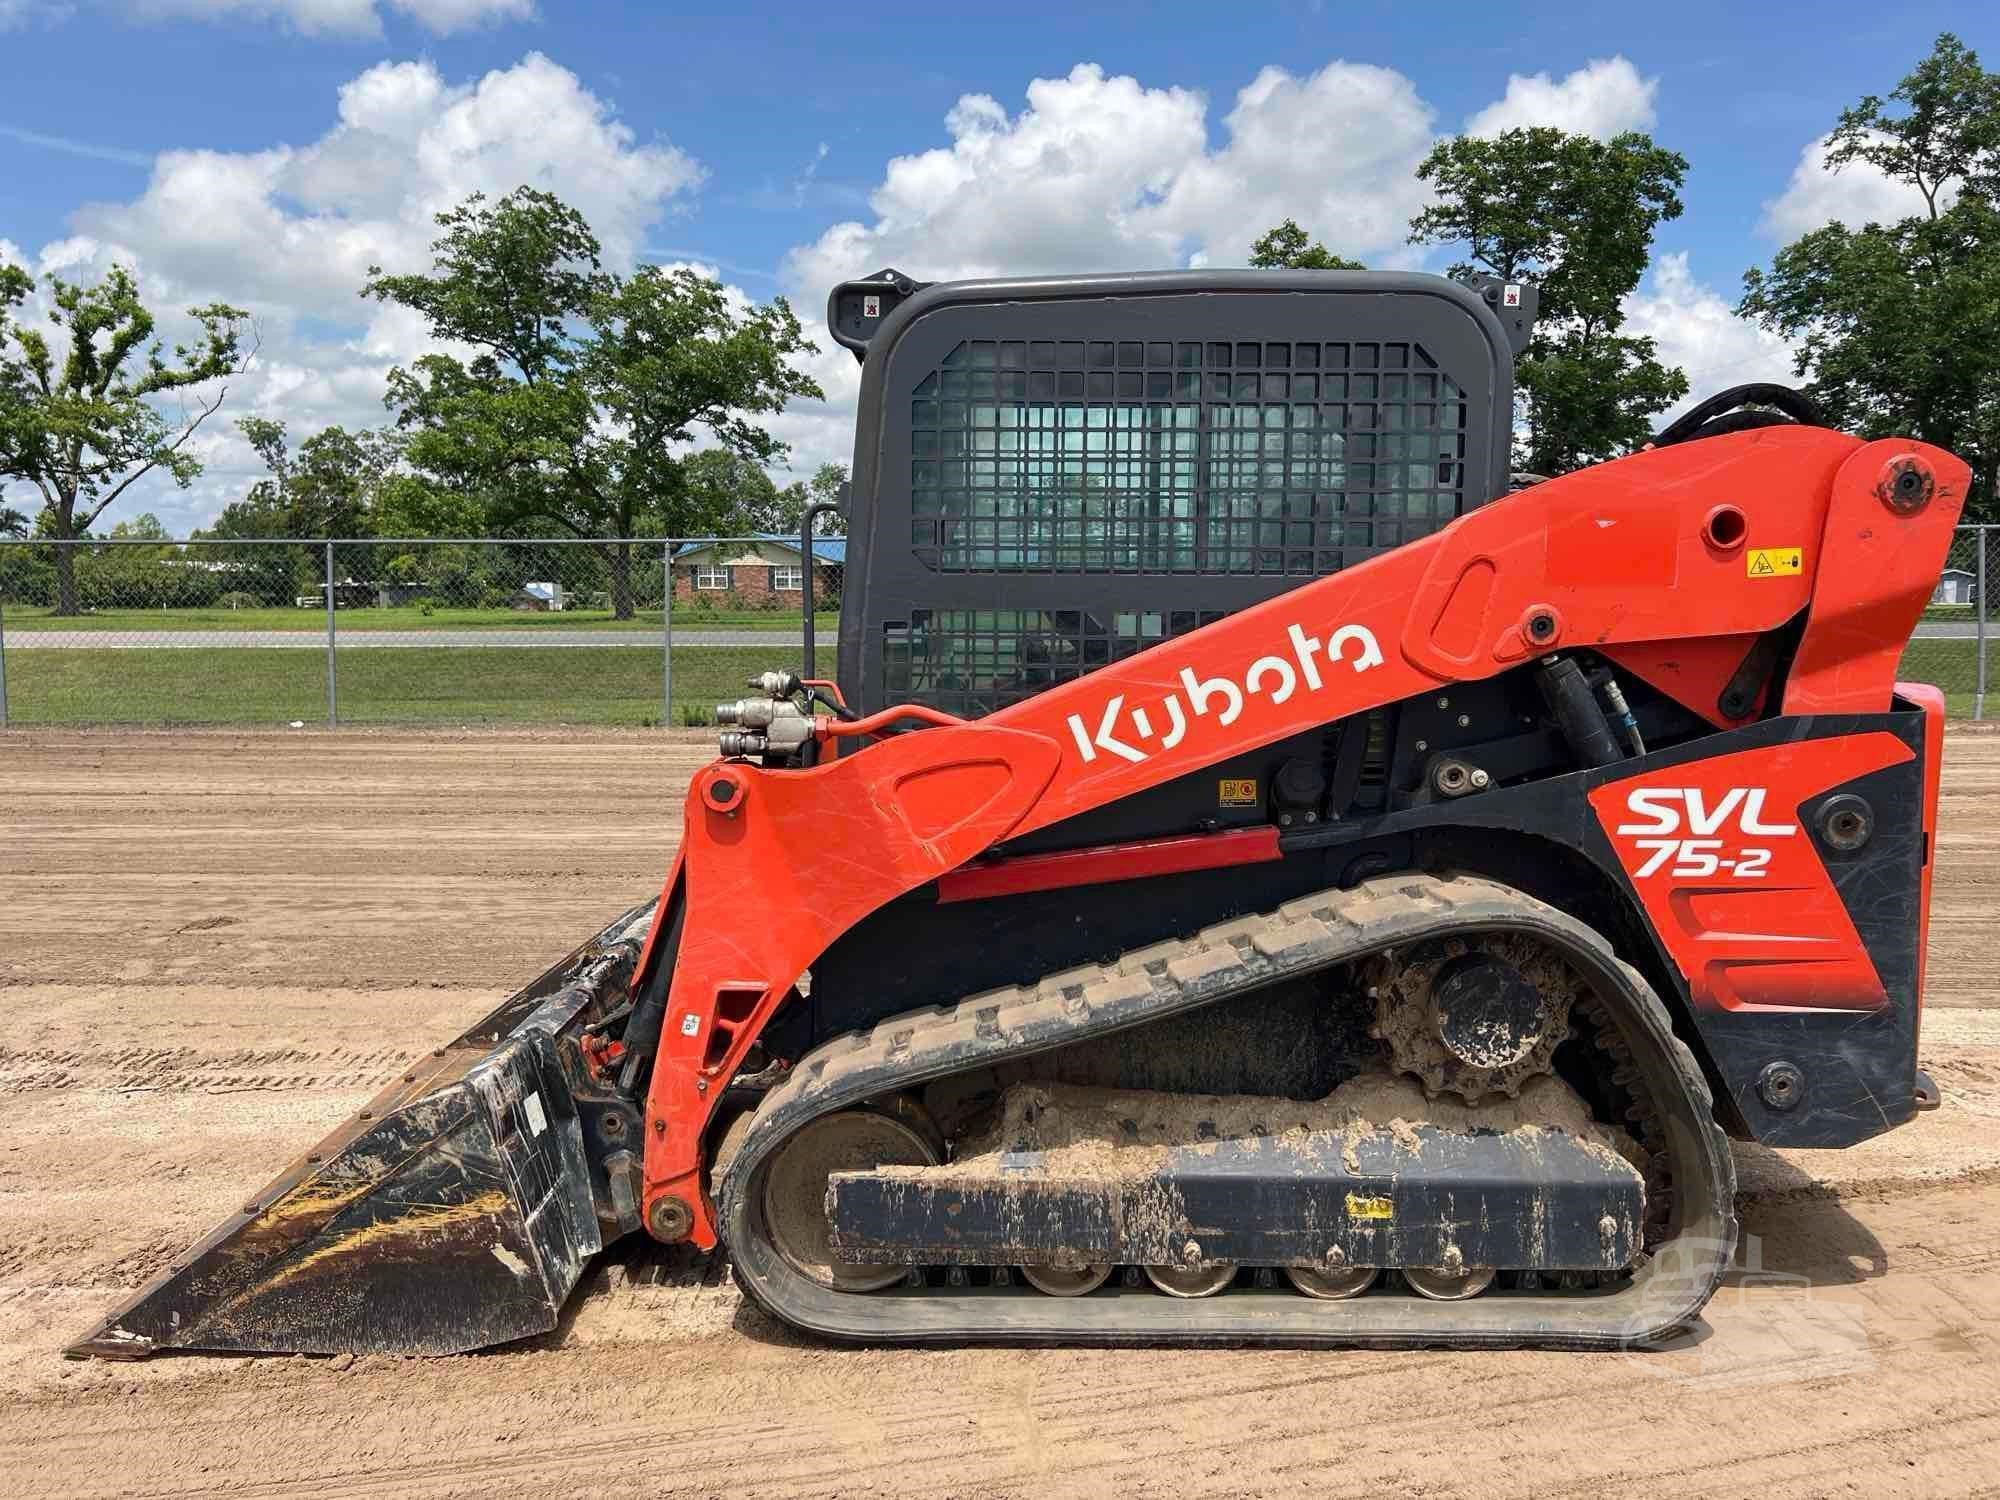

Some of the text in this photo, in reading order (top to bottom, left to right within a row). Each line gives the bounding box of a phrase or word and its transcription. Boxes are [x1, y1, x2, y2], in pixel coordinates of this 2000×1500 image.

[1066, 624, 1385, 763] Kubota
[1617, 788, 1797, 836] SVL
[1634, 839, 1773, 878] 75-2
